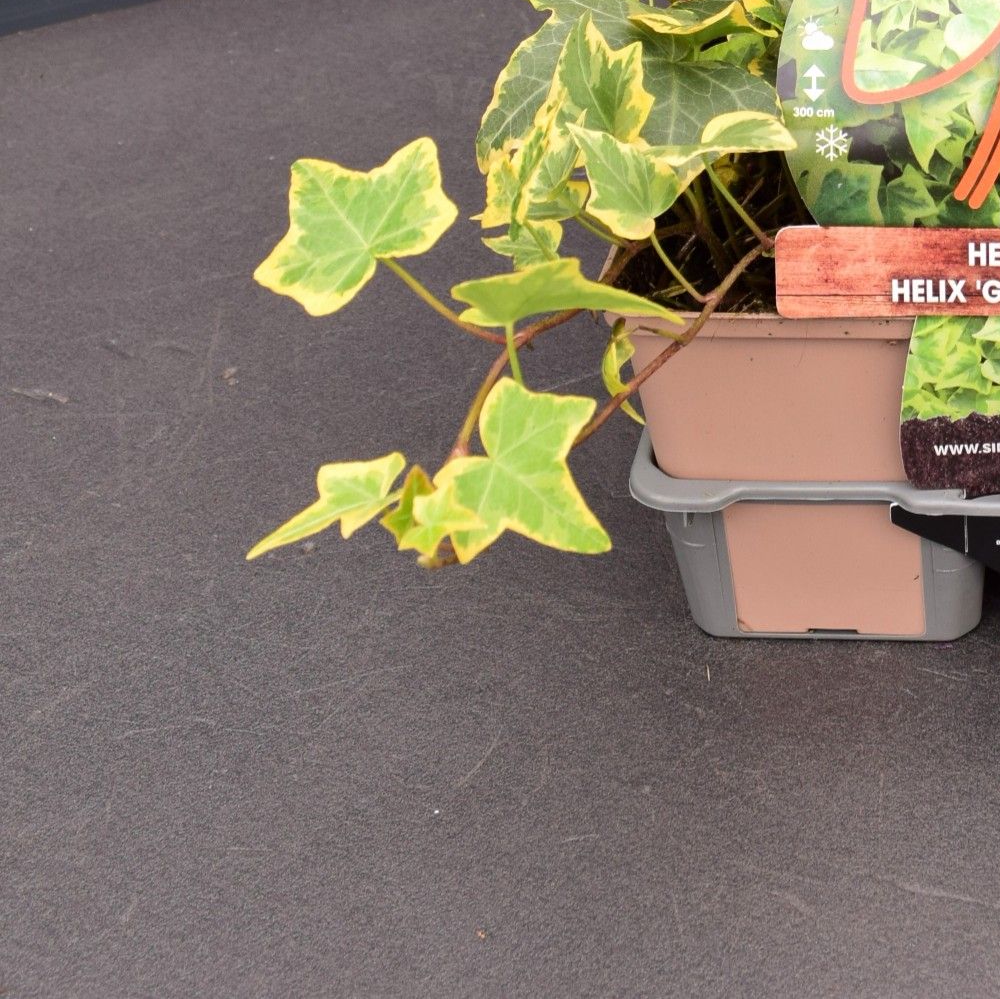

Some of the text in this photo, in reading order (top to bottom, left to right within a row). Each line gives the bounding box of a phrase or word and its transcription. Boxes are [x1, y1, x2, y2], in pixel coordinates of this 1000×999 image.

[793, 106, 835, 117] 300 cm
[891, 279, 968, 305] HELIX
